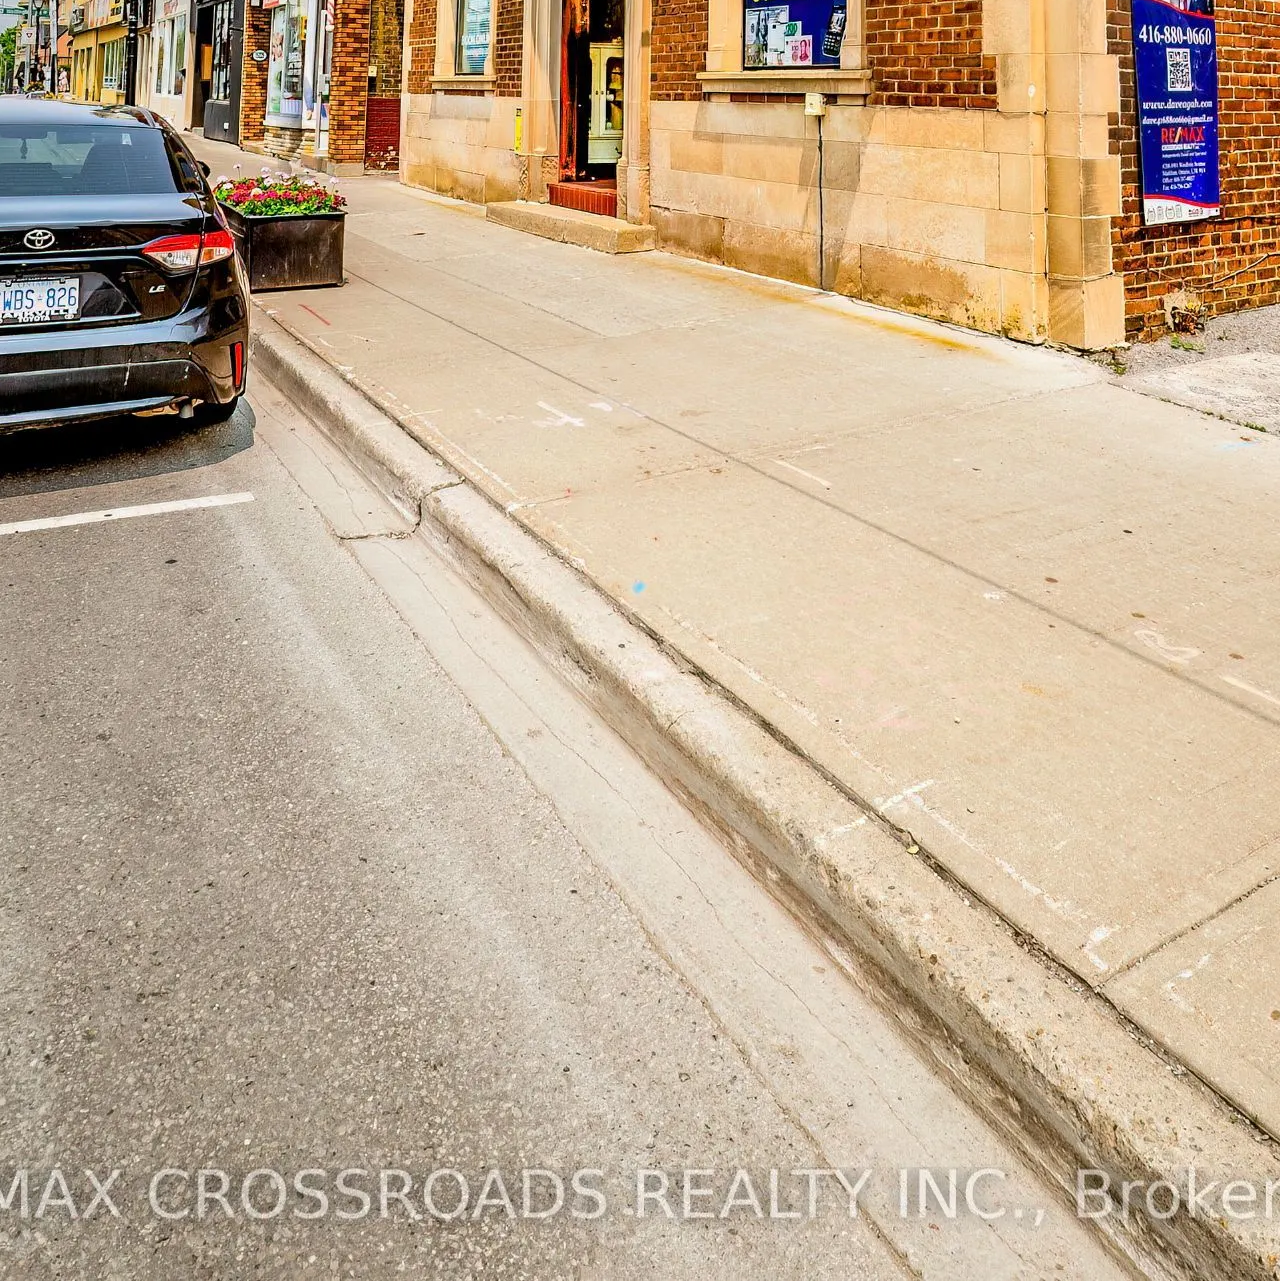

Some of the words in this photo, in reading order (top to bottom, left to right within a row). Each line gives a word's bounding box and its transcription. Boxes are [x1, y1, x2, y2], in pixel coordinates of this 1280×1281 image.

[1139, 24, 1212, 46] 416-880-0660
[1161, 126, 1205, 143] RE/MAX
[148, 284, 166, 293] LE
[18, 315, 51, 323] TOYOTA
